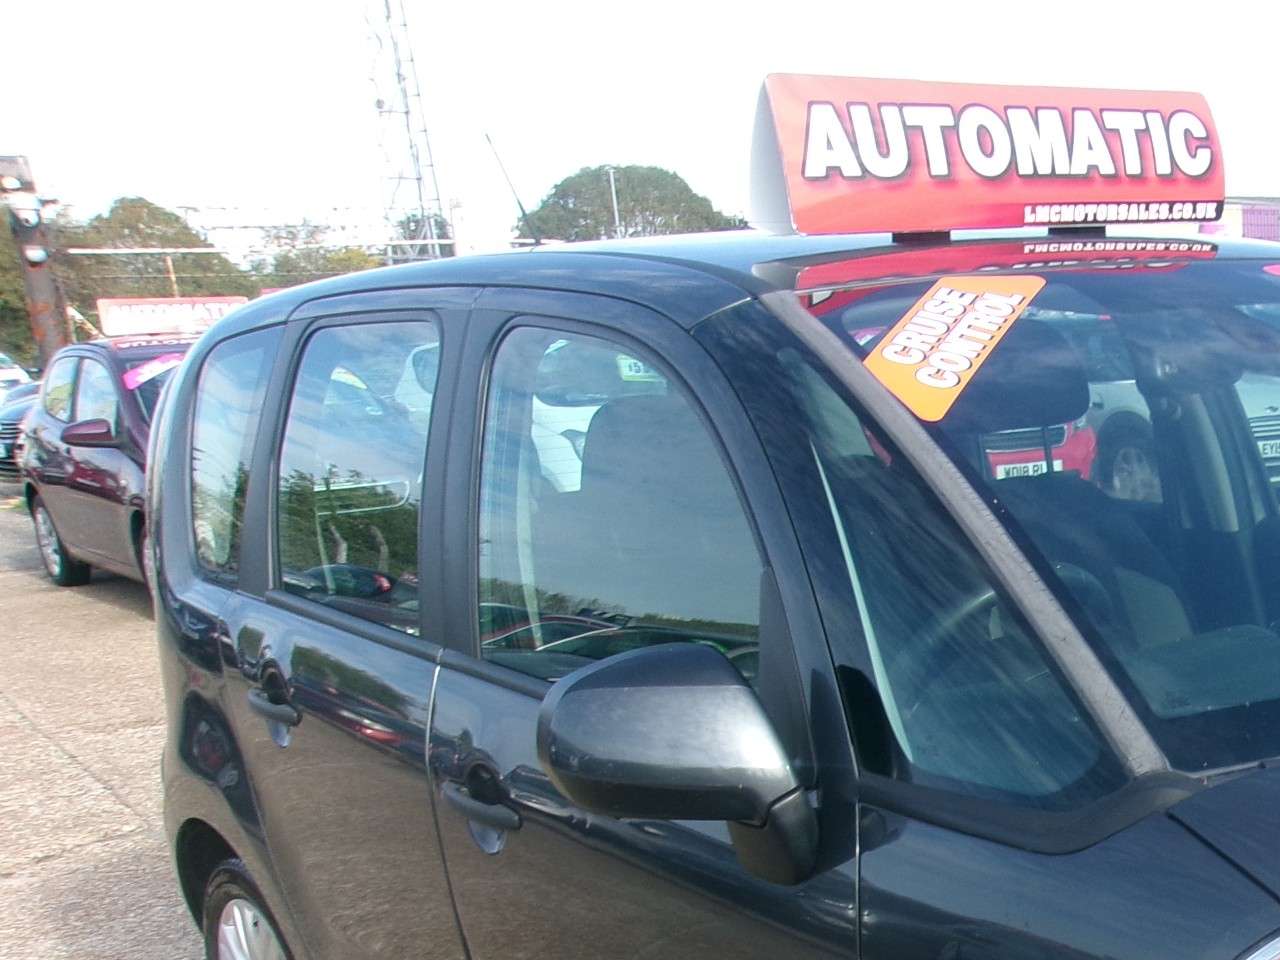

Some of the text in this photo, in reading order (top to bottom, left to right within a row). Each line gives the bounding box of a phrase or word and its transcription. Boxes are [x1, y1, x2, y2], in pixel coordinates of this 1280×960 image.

[802, 102, 1213, 179] AUTOMATIC
[882, 287, 979, 365] CRUISE
[915, 292, 1026, 389] CONTROL
